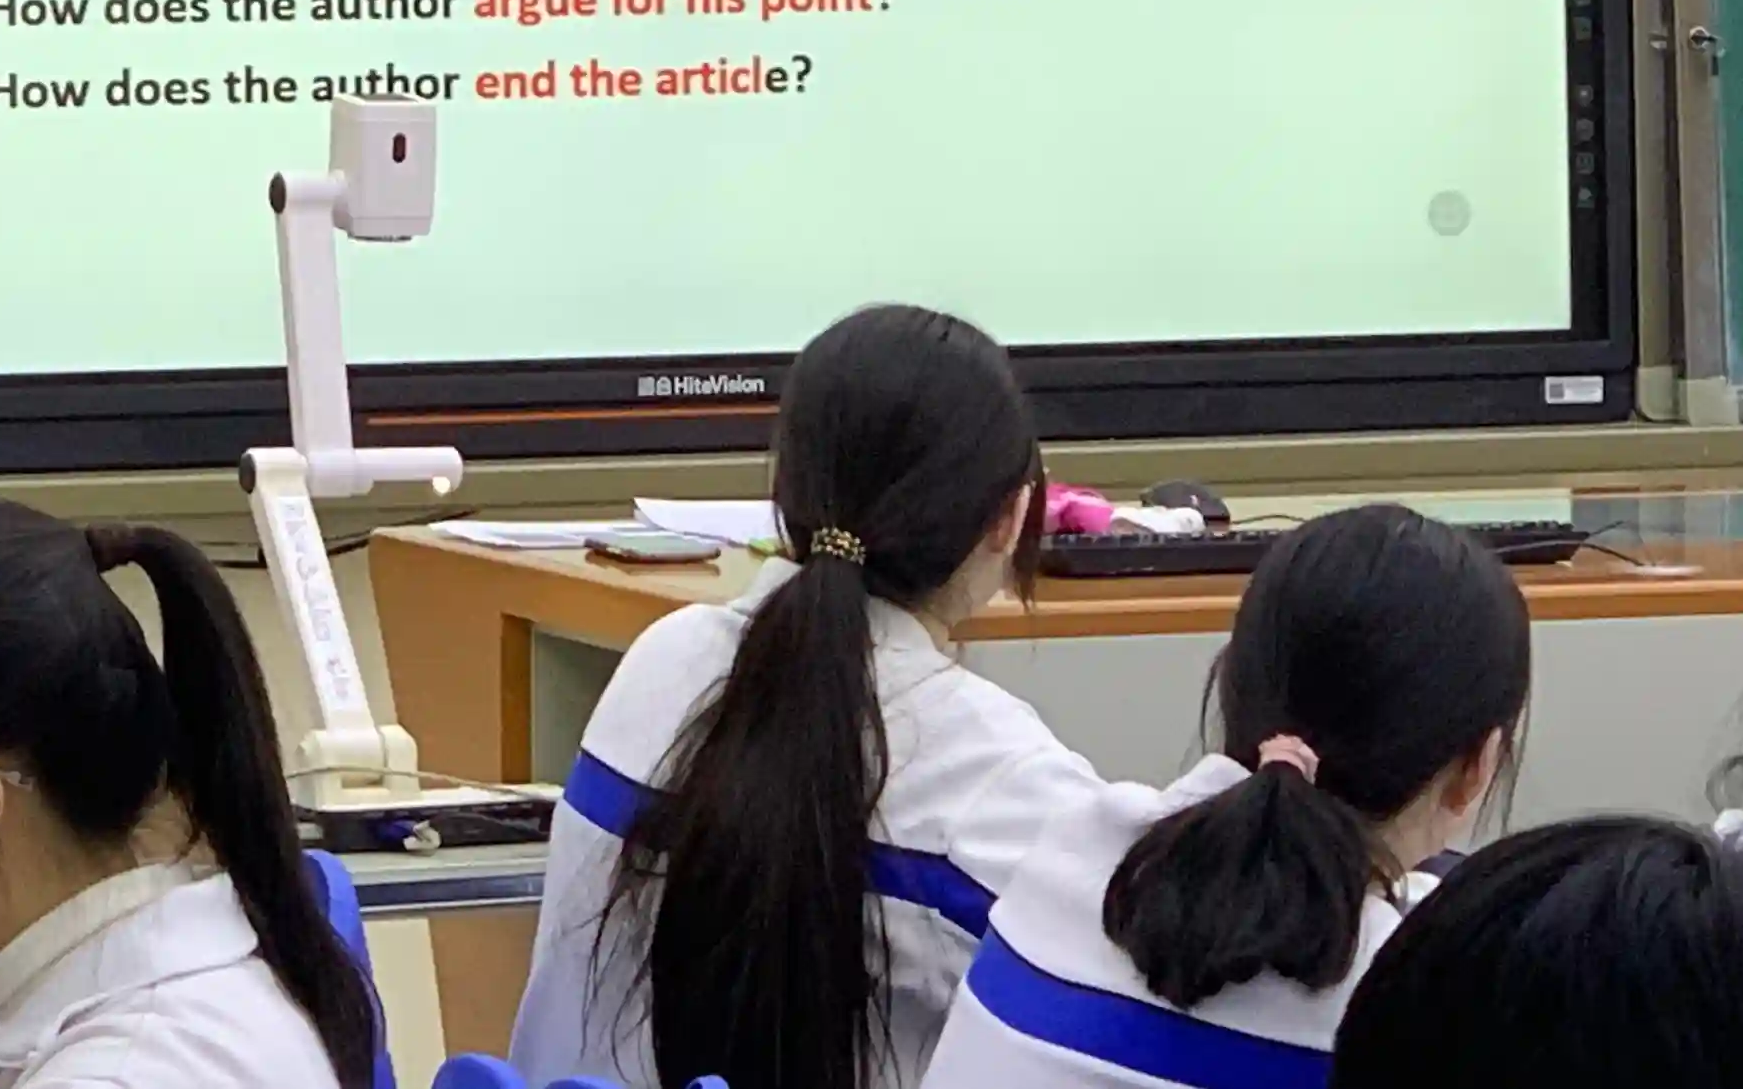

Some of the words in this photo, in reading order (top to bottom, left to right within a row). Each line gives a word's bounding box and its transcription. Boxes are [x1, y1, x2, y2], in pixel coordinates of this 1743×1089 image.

[105, 67, 211, 107] does
[223, 65, 298, 104] the
[311, 62, 461, 102] author
[475, 60, 556, 99] end
[569, 58, 643, 97] the
[656, 54, 813, 95] article?
